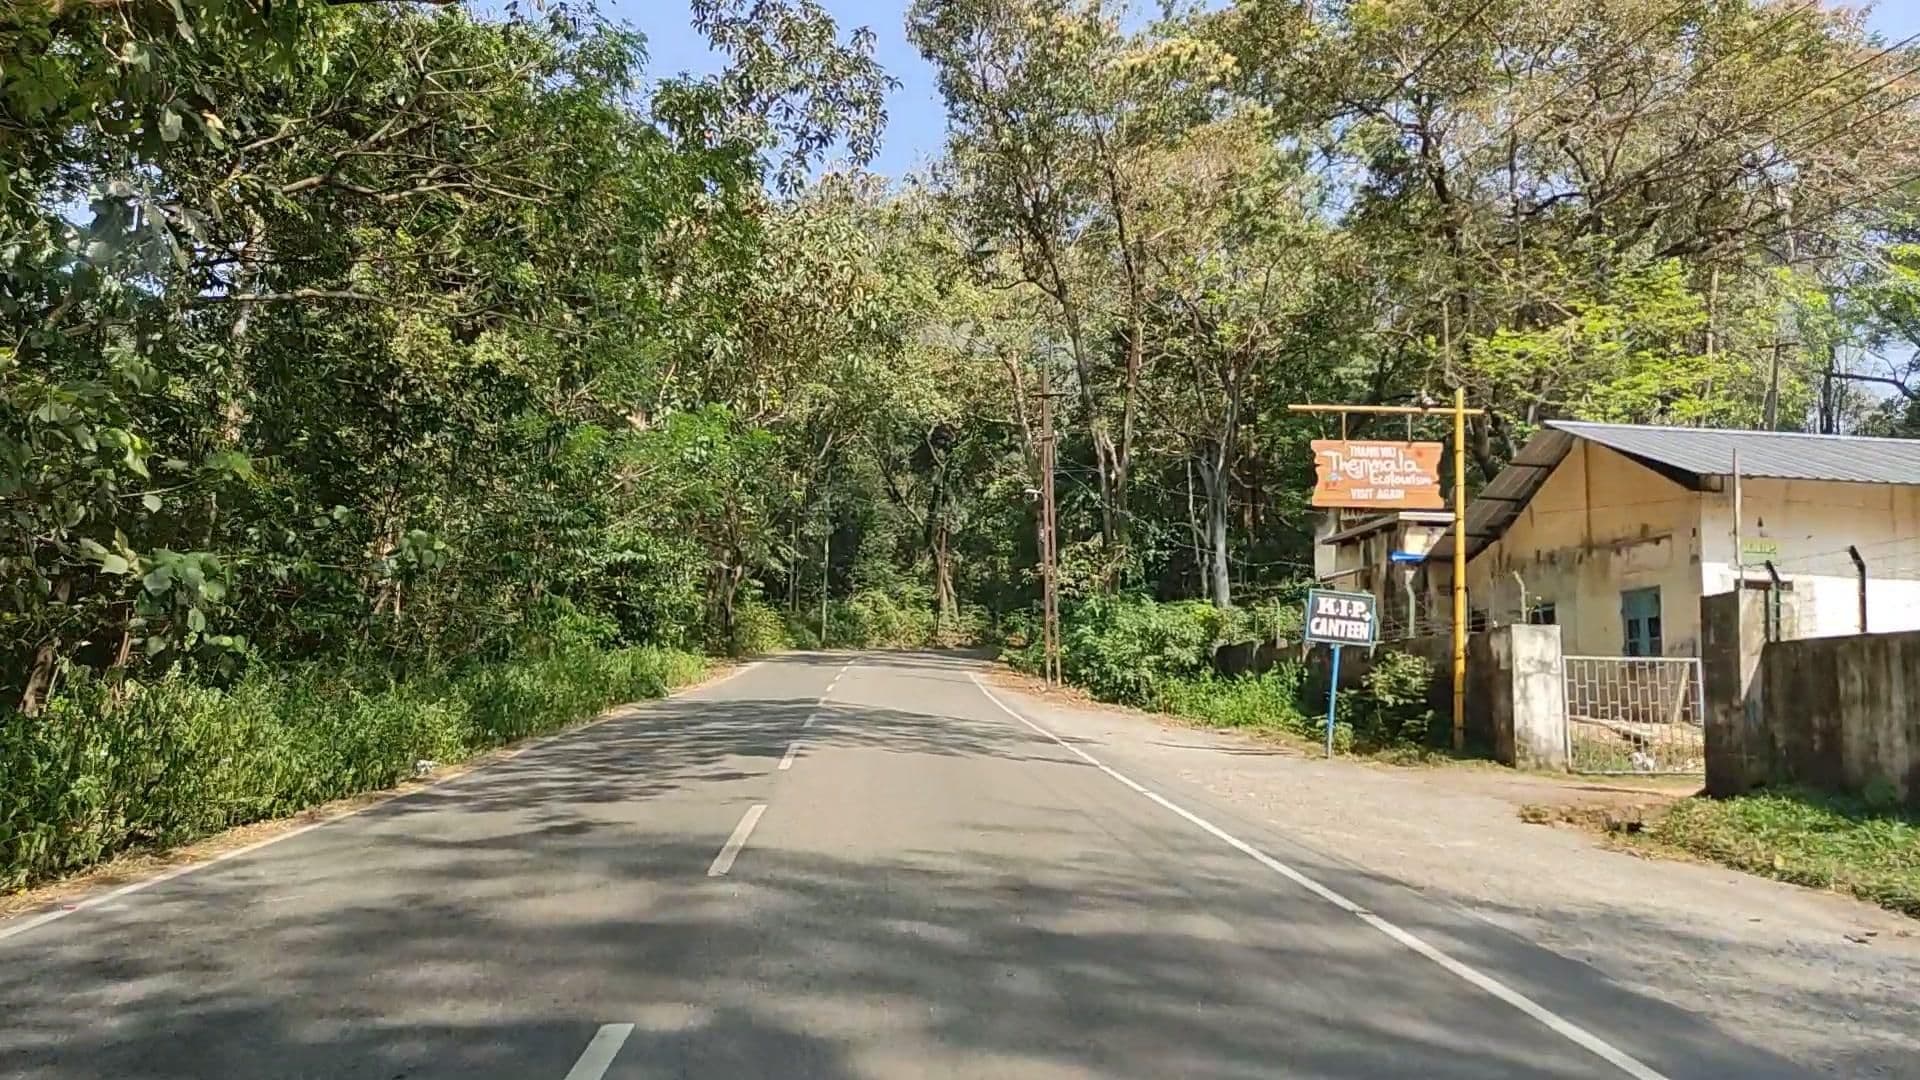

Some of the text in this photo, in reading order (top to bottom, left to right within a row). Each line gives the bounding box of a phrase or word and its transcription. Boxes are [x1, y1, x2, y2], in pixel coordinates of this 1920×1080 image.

[1351, 488, 1405, 501] VISIT AGAIN
[1310, 617, 1370, 640] CANTEEN
